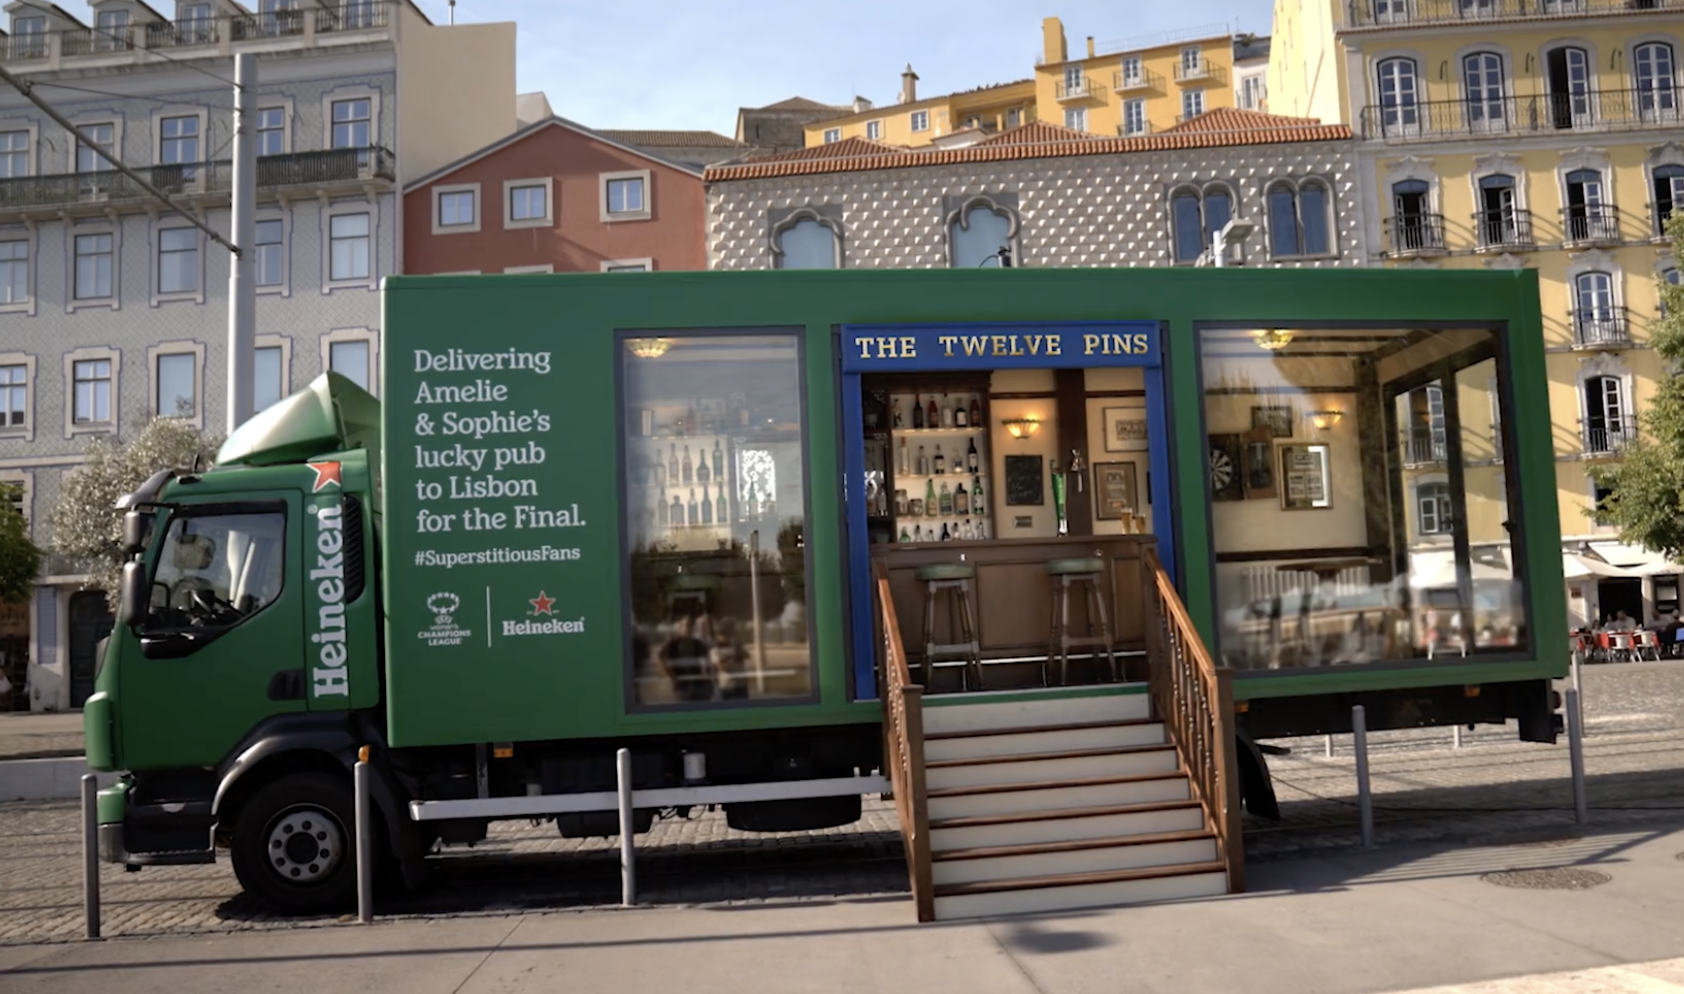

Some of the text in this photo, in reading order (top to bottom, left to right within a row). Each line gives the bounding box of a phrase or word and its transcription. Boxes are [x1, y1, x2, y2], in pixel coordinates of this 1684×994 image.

[855, 334, 1149, 359] THE TWELVE PINS
[413, 347, 552, 375] Delivering
[413, 379, 508, 404] Amelie
[414, 408, 551, 440] & Sophie’s
[415, 441, 547, 472] lucky pub
[416, 475, 538, 500] to Lisbon
[416, 503, 587, 533] for the Final.
[414, 545, 581, 569] #SuperstitiousFans
[310, 504, 350, 698] Heineken
[417, 629, 471, 639] CHAMPIONS
[502, 618, 585, 636] Heineken
[428, 637, 461, 646] LEAGUE
